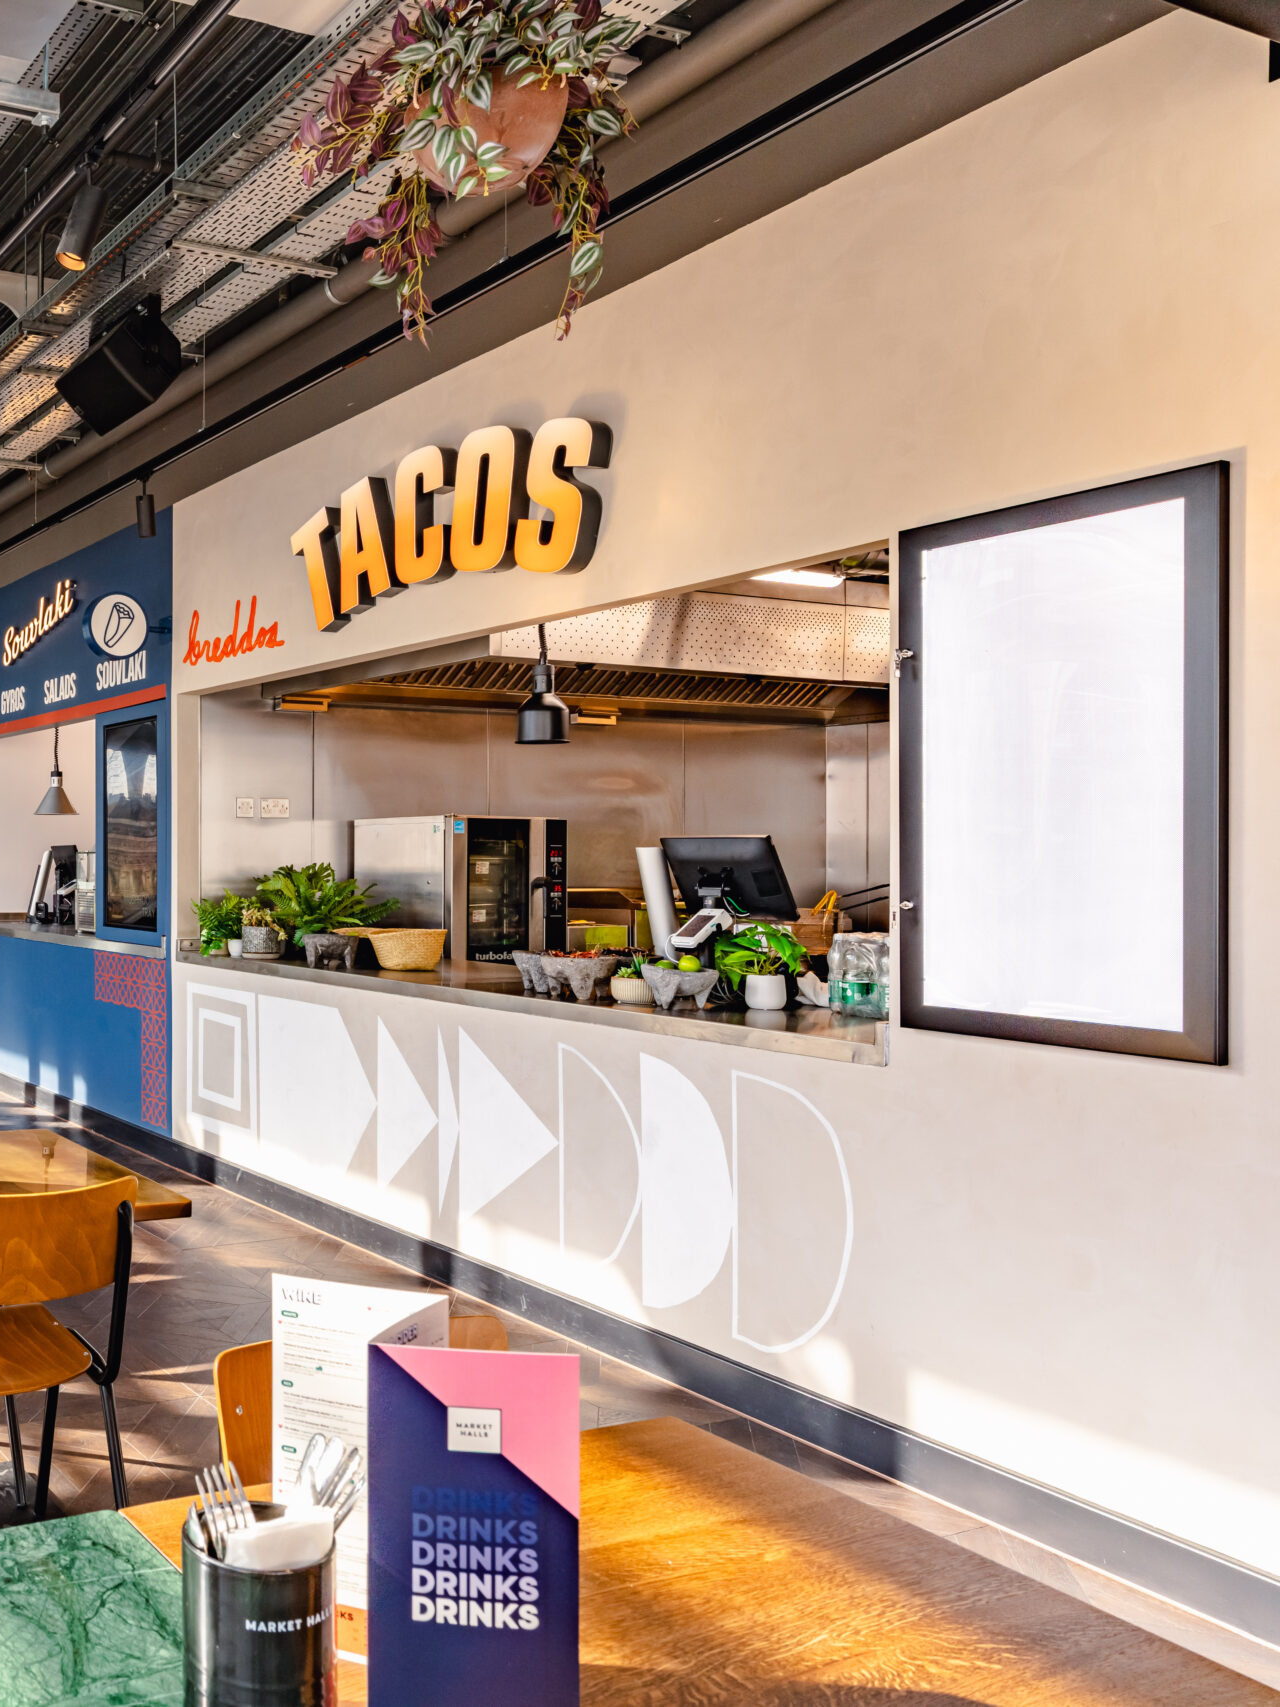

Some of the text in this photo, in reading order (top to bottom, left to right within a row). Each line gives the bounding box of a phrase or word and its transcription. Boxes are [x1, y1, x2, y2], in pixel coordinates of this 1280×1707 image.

[290, 417, 614, 632] TACOS
[3, 579, 73, 667] Souvlaki
[183, 596, 285, 667] breddos
[1, 686, 26, 715] GYROS
[44, 672, 77, 705] SALADS
[96, 650, 147, 691] SOUVLAKI
[475, 951, 513, 961] turbofa
[456, 1422, 493, 1430] MARKET
[460, 1430, 489, 1438] HALLS
[412, 1512, 539, 1545] DRINKS
[412, 1540, 539, 1573] DRINKS
[411, 1567, 540, 1602] DRINKS
[245, 1618, 302, 1633] MARKET
[411, 1595, 540, 1631] DRINKS
